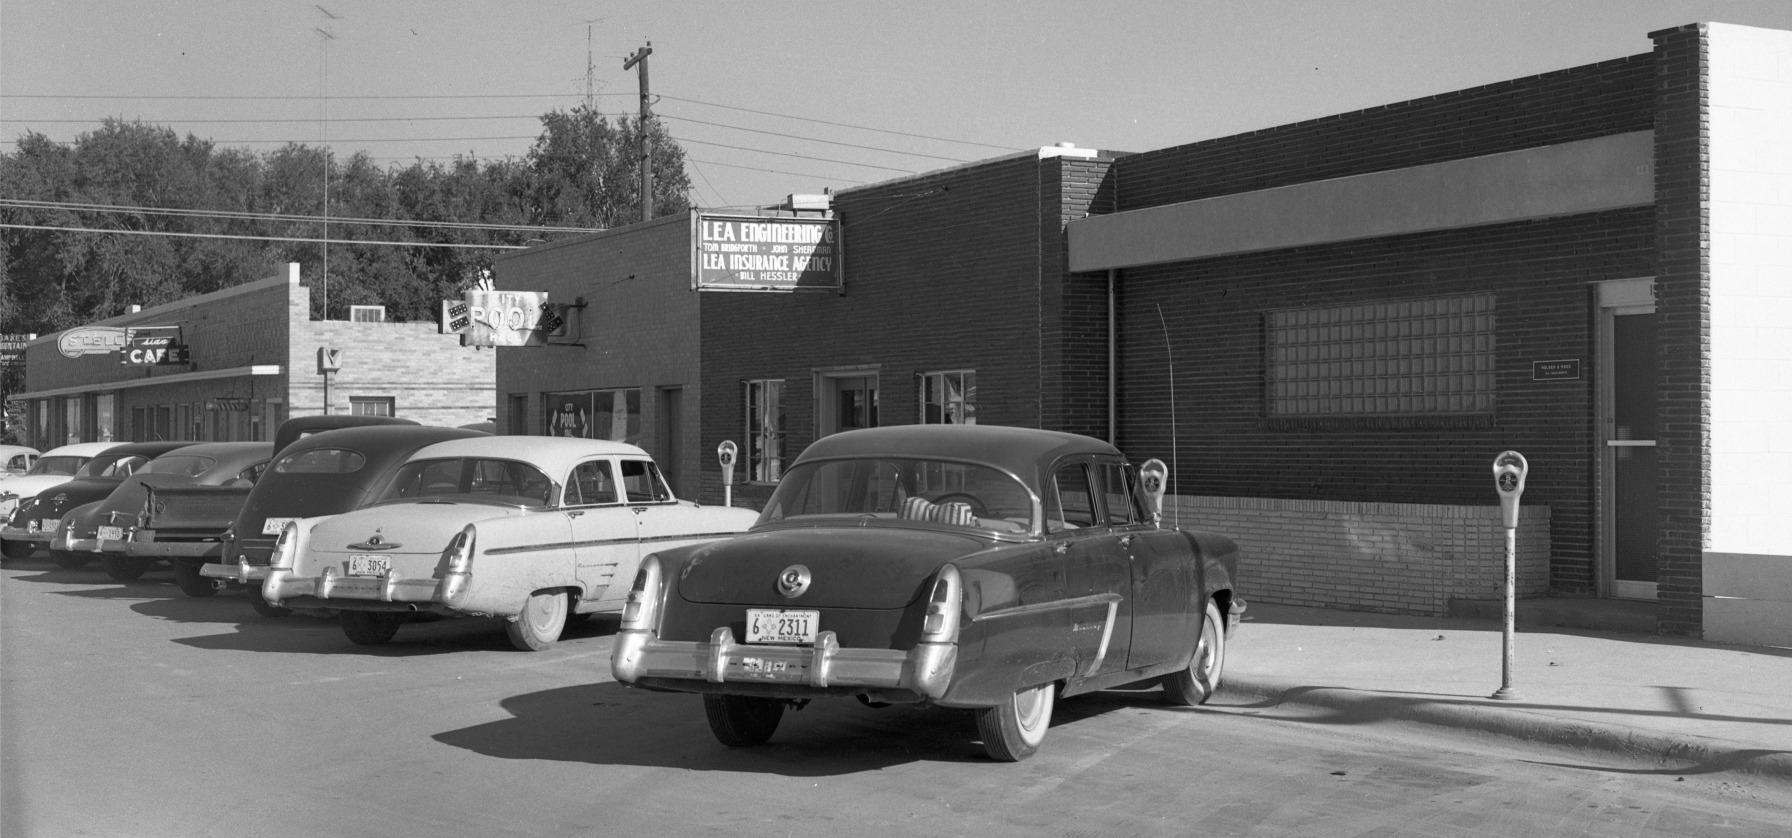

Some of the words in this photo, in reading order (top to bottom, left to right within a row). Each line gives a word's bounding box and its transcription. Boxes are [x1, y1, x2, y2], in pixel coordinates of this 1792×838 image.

[703, 221, 736, 242] LEA
[740, 222, 822, 243] ENGINEERING
[703, 243, 719, 252] TOM
[721, 244, 757, 252] BRIDGFORTH
[770, 245, 788, 253] JOHN
[793, 246, 831, 254] SHERMAN
[703, 253, 726, 270] LEA
[730, 254, 789, 271] INSURANCE
[793, 255, 832, 272] AGENCY
[740, 272, 755, 280] BILL
[760, 272, 798, 281] HESSLER
[491, 294, 521, 305] CITY
[470, 306, 543, 331] POOL
[130, 348, 180, 364] CAFE
[565, 403, 573, 411] CITY
[560, 412, 576, 428] POOL
[352, 559, 357, 570] 6
[367, 559, 387, 571] 3054
[753, 618, 759, 634] 6
[778, 618, 809, 636] 2311
